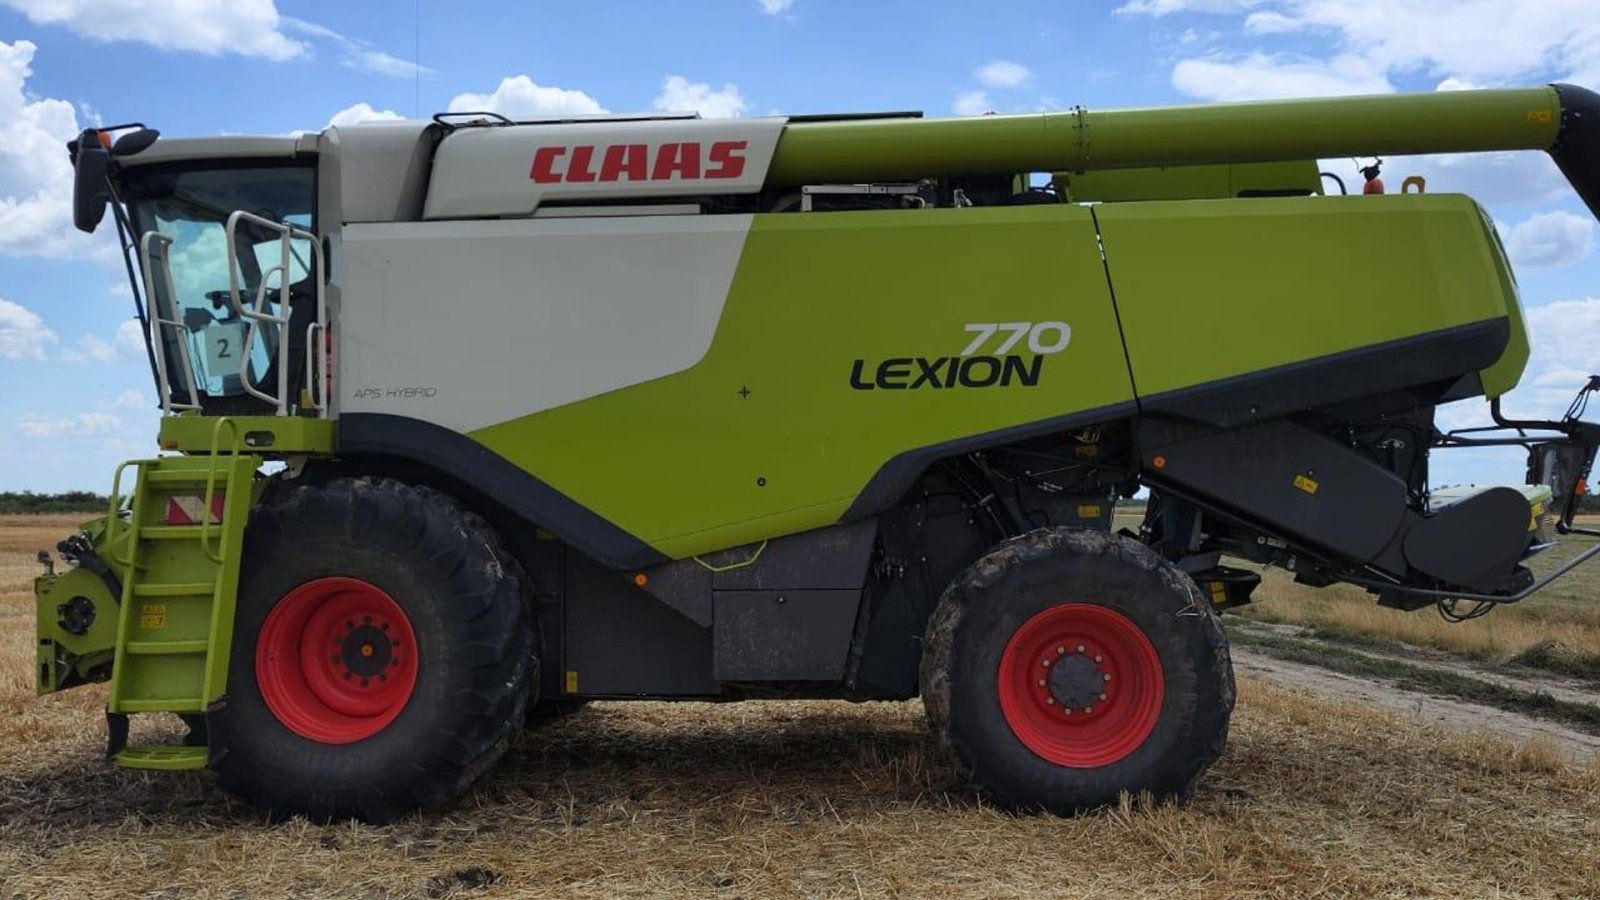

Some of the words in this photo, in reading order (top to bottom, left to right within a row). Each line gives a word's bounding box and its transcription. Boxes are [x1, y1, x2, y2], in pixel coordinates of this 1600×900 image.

[530, 141, 748, 184] CLAAS
[217, 339, 231, 358] 2
[960, 321, 1072, 356] 770
[850, 354, 1044, 390] LEXION
[353, 387, 382, 400] APS
[385, 387, 437, 399] HYBRID
